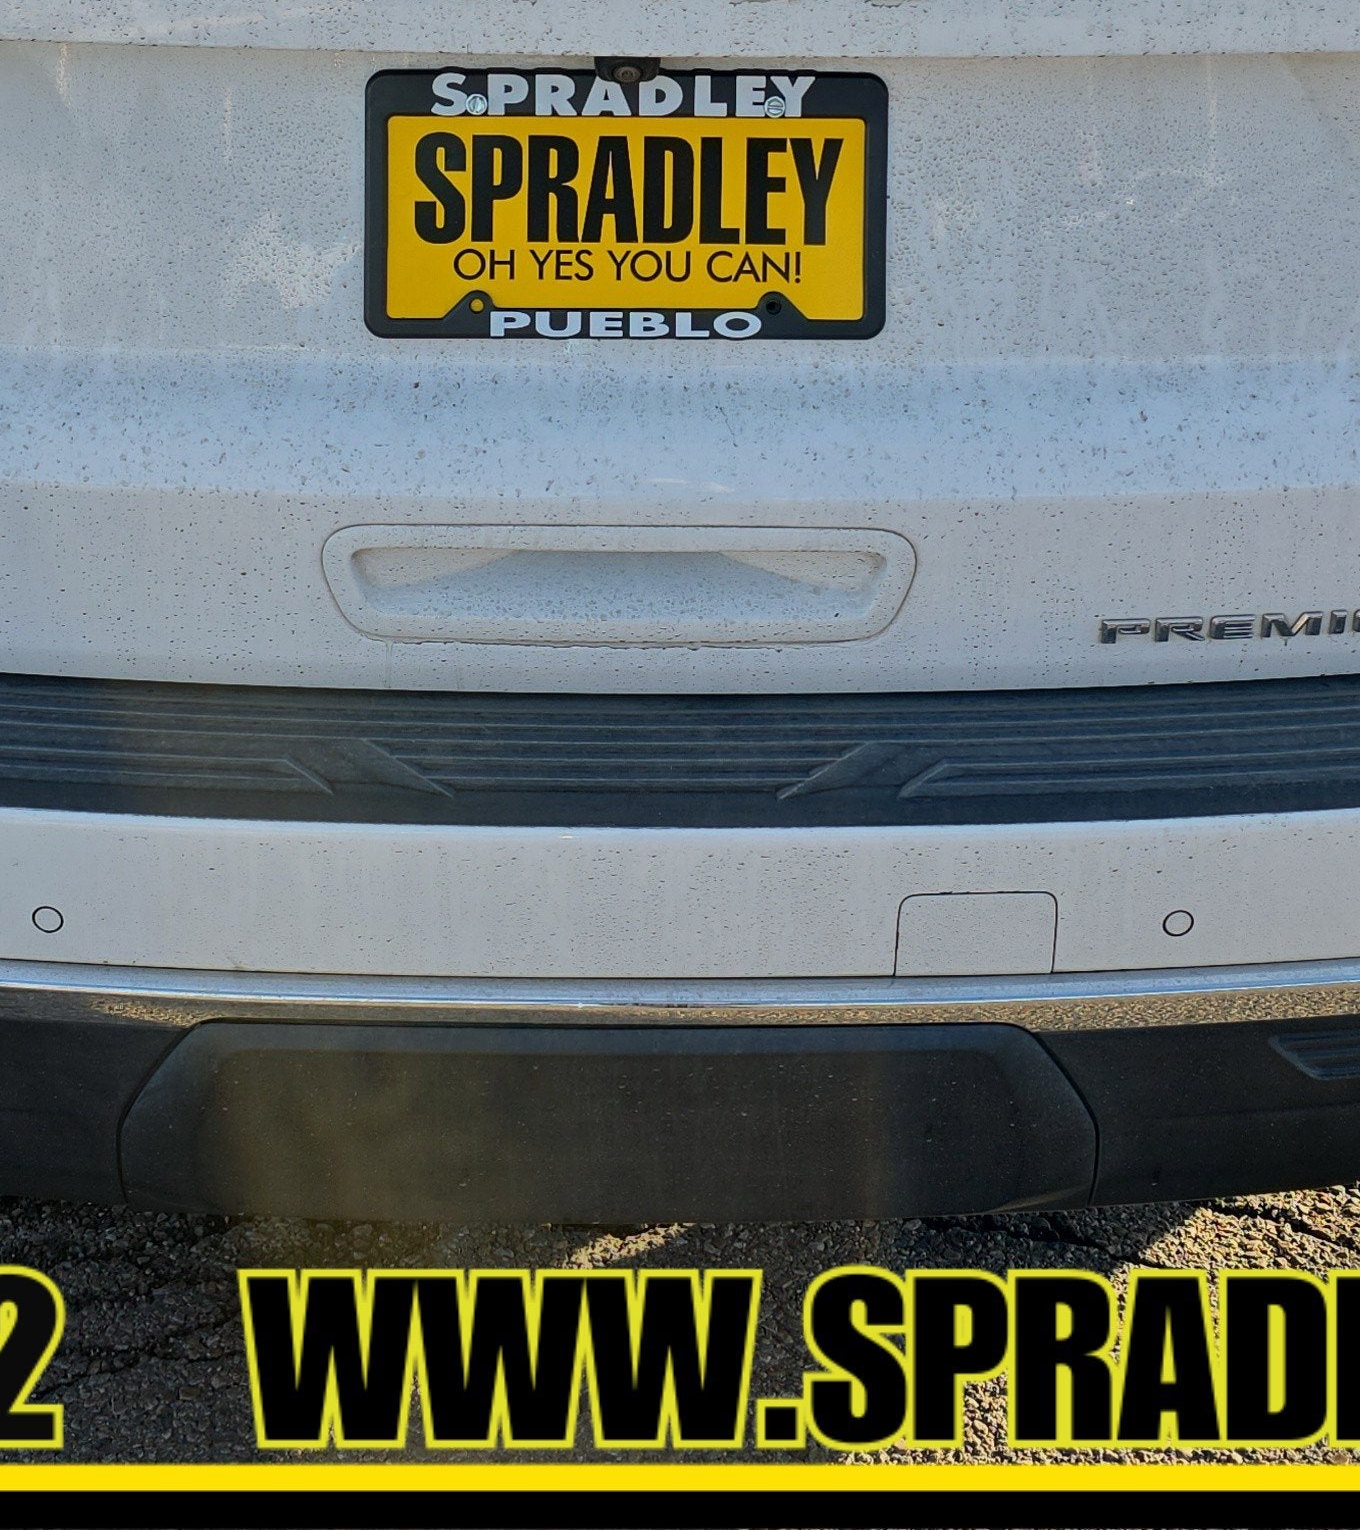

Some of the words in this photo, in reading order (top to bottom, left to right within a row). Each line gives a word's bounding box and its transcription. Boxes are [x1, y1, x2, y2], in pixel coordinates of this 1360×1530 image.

[431, 72, 815, 119] SPRADLEY
[414, 131, 843, 247] SPRADLEY
[453, 248, 515, 281] OH
[530, 249, 594, 282] YES
[608, 249, 691, 283] YOU
[706, 250, 802, 284] CAN!
[489, 311, 762, 339] PUEBLO
